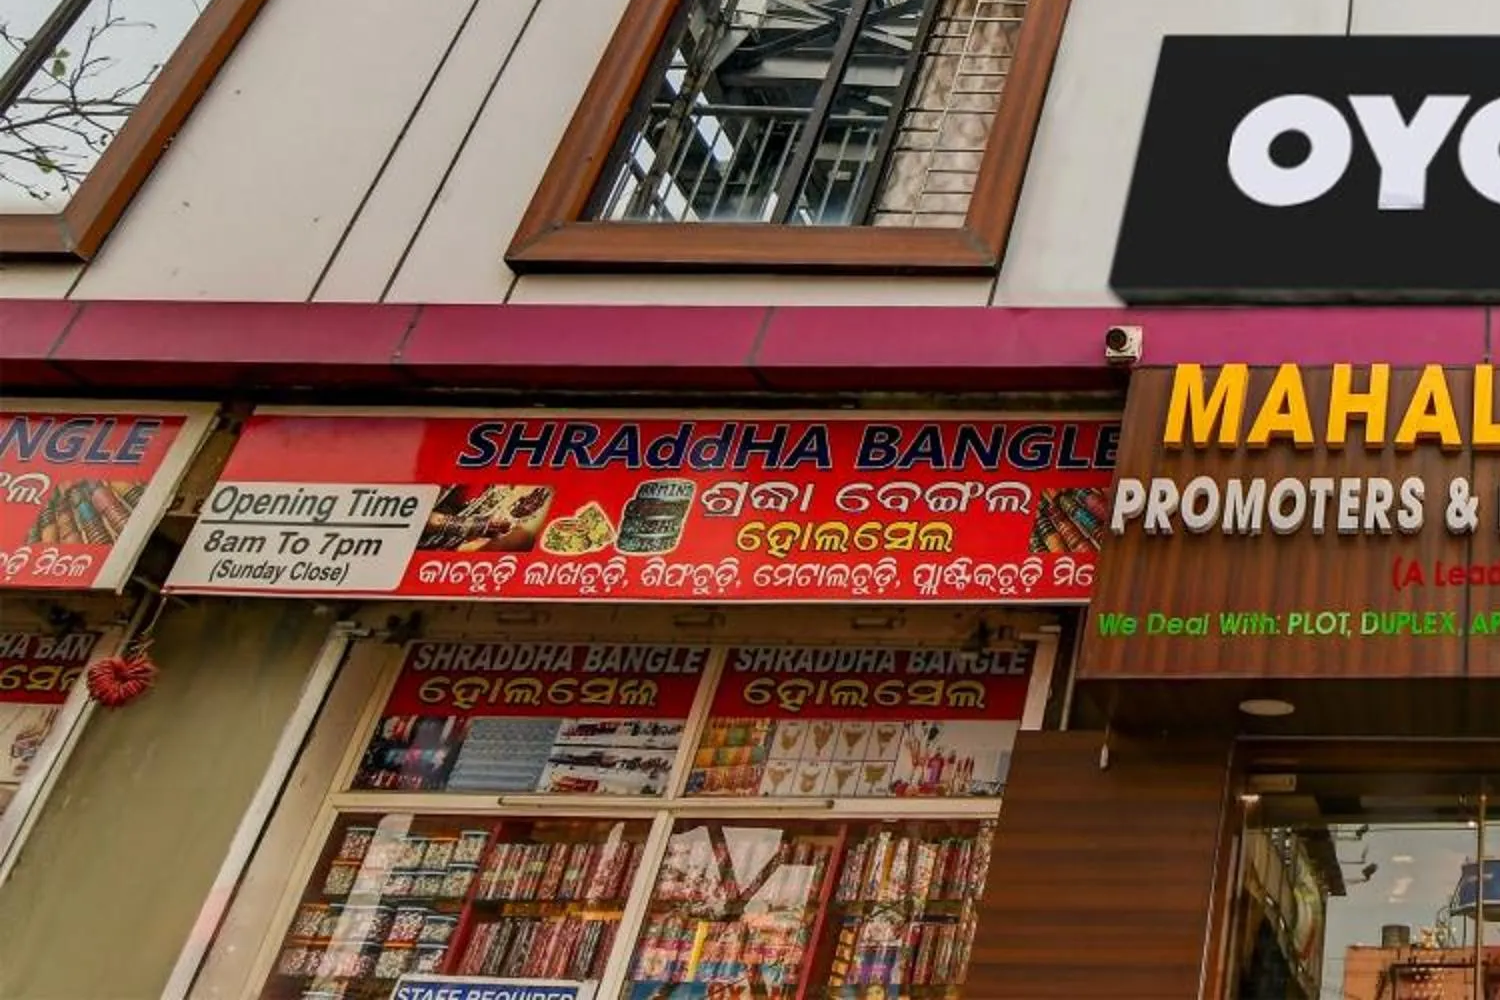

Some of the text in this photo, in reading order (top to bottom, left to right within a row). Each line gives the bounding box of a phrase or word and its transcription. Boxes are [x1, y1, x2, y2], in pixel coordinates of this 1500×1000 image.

[456, 422, 833, 470] SHRAddHA
[211, 485, 419, 523] Opening Time
[1110, 476, 1426, 536] PROMOTERS
[1445, 476, 1480, 535] &
[203, 530, 382, 561] 8am To 7pm
[208, 558, 349, 584] (Sunday Close)
[1098, 612, 1137, 635] We
[1146, 612, 1210, 635] Deal
[1219, 611, 1282, 635] With:
[1287, 611, 1352, 638] PLOT,
[413, 643, 704, 673] SHRADDHA BANGLE
[734, 647, 1028, 676] SHRADDHA BANGLE
